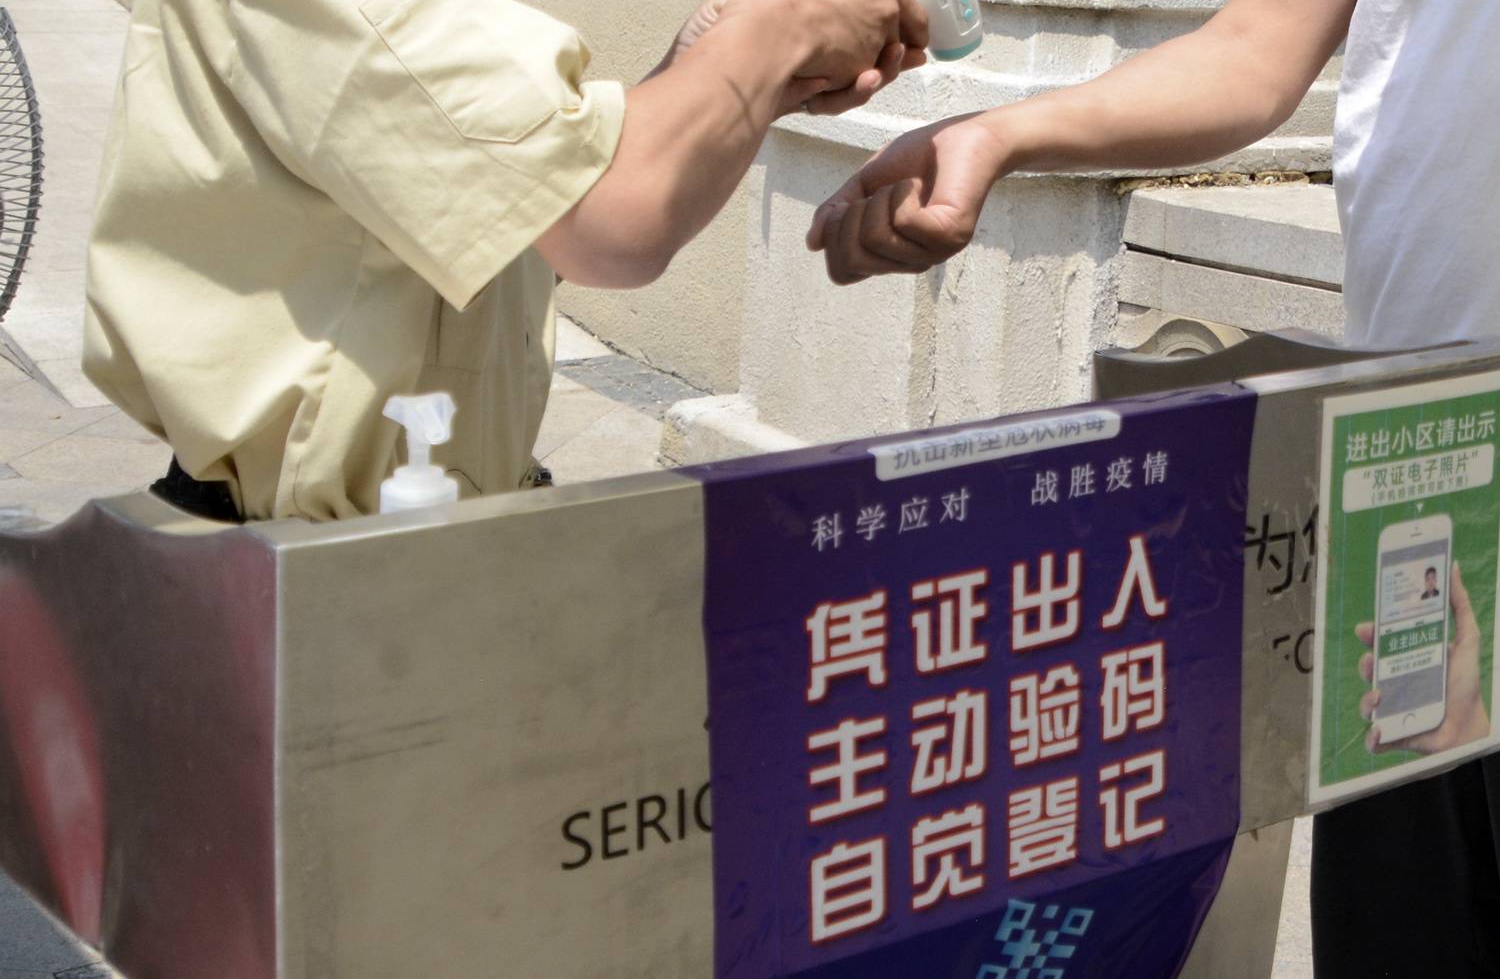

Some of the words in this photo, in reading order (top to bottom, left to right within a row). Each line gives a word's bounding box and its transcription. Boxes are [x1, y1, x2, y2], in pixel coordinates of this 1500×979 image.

[810, 488, 970, 552] 科学应对
[1031, 451, 1169, 506] 战胜疫情
[1345, 412, 1496, 463] 进出小区请出示
[805, 536, 1167, 703] 凭证出入
[807, 641, 1166, 823] 主动验码
[809, 750, 1166, 943] 自觉登记
